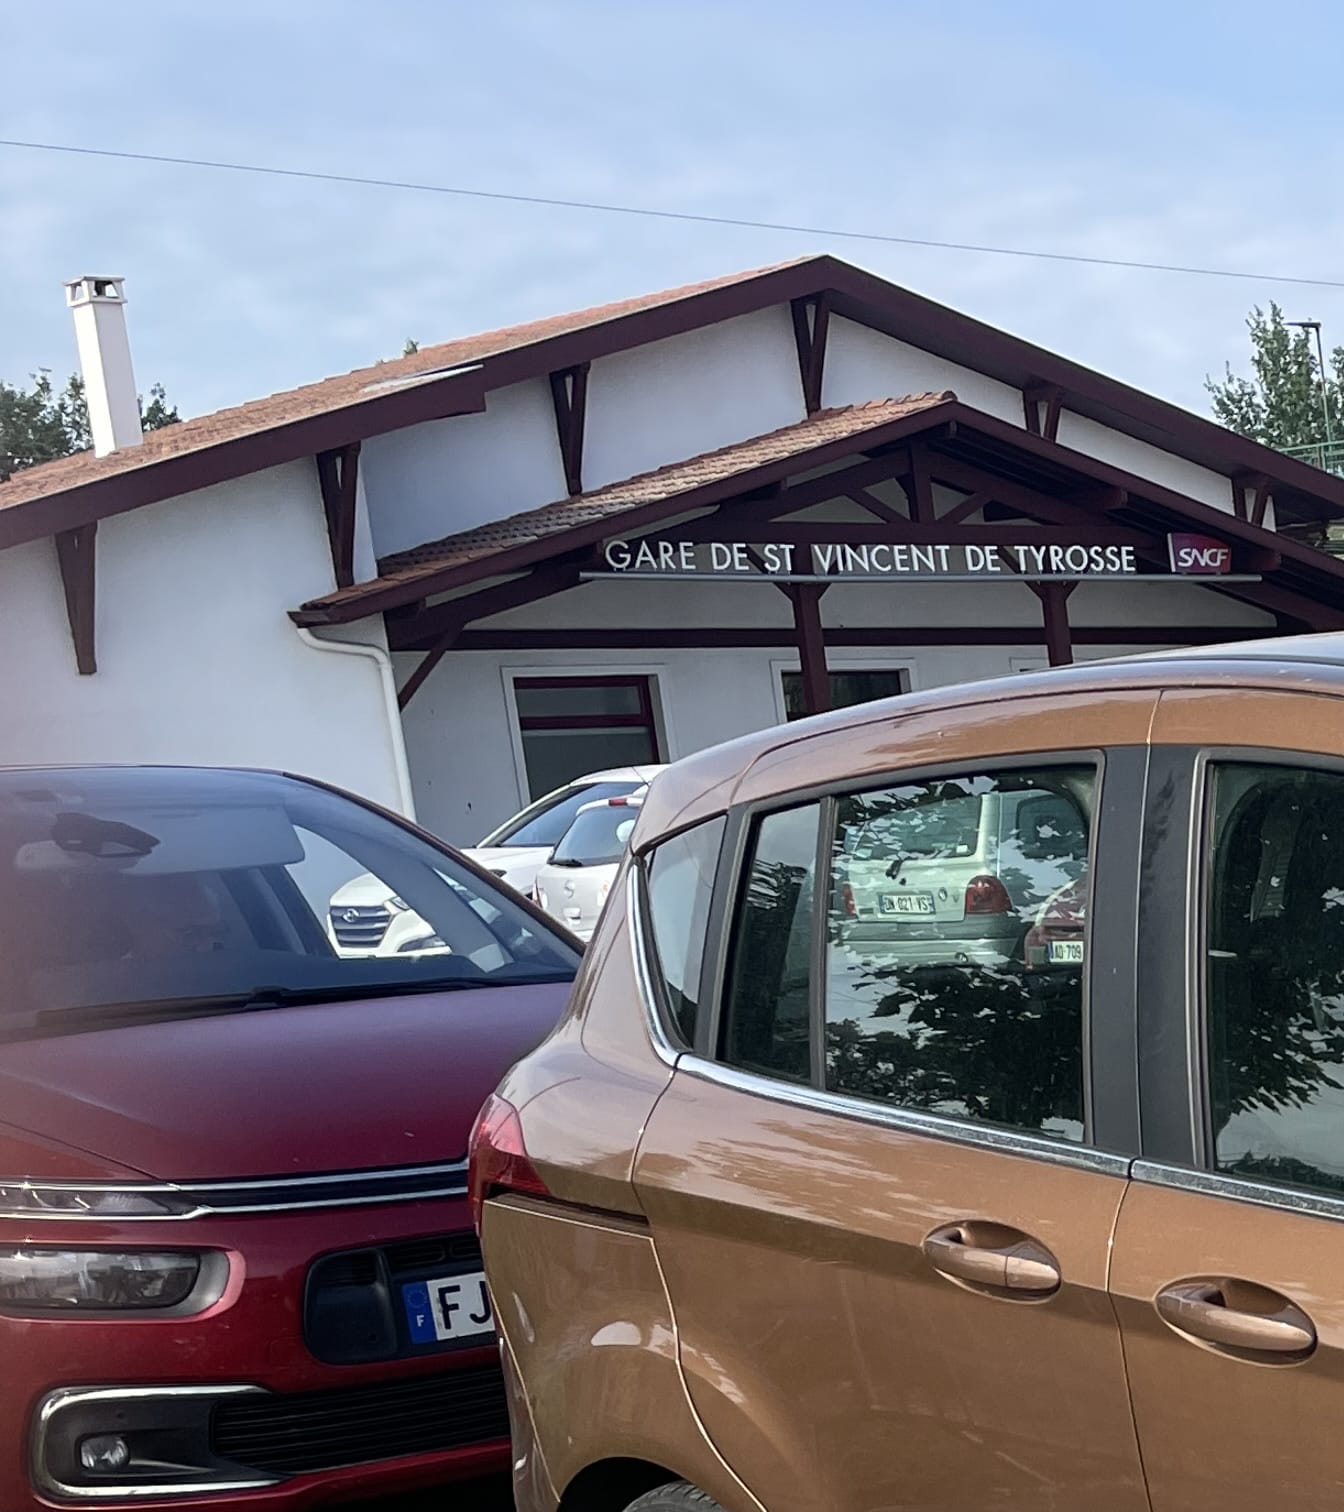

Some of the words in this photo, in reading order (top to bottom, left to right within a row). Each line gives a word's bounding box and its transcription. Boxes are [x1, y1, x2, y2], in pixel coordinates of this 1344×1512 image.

[605, 541, 696, 569] GARE
[711, 543, 749, 571] DE
[764, 544, 795, 572] ST
[813, 544, 950, 573] VINCENT
[966, 545, 1000, 572] DE
[1014, 545, 1136, 573] TYROSSE
[1178, 548, 1228, 567] SNCF
[416, 1314, 425, 1328] F
